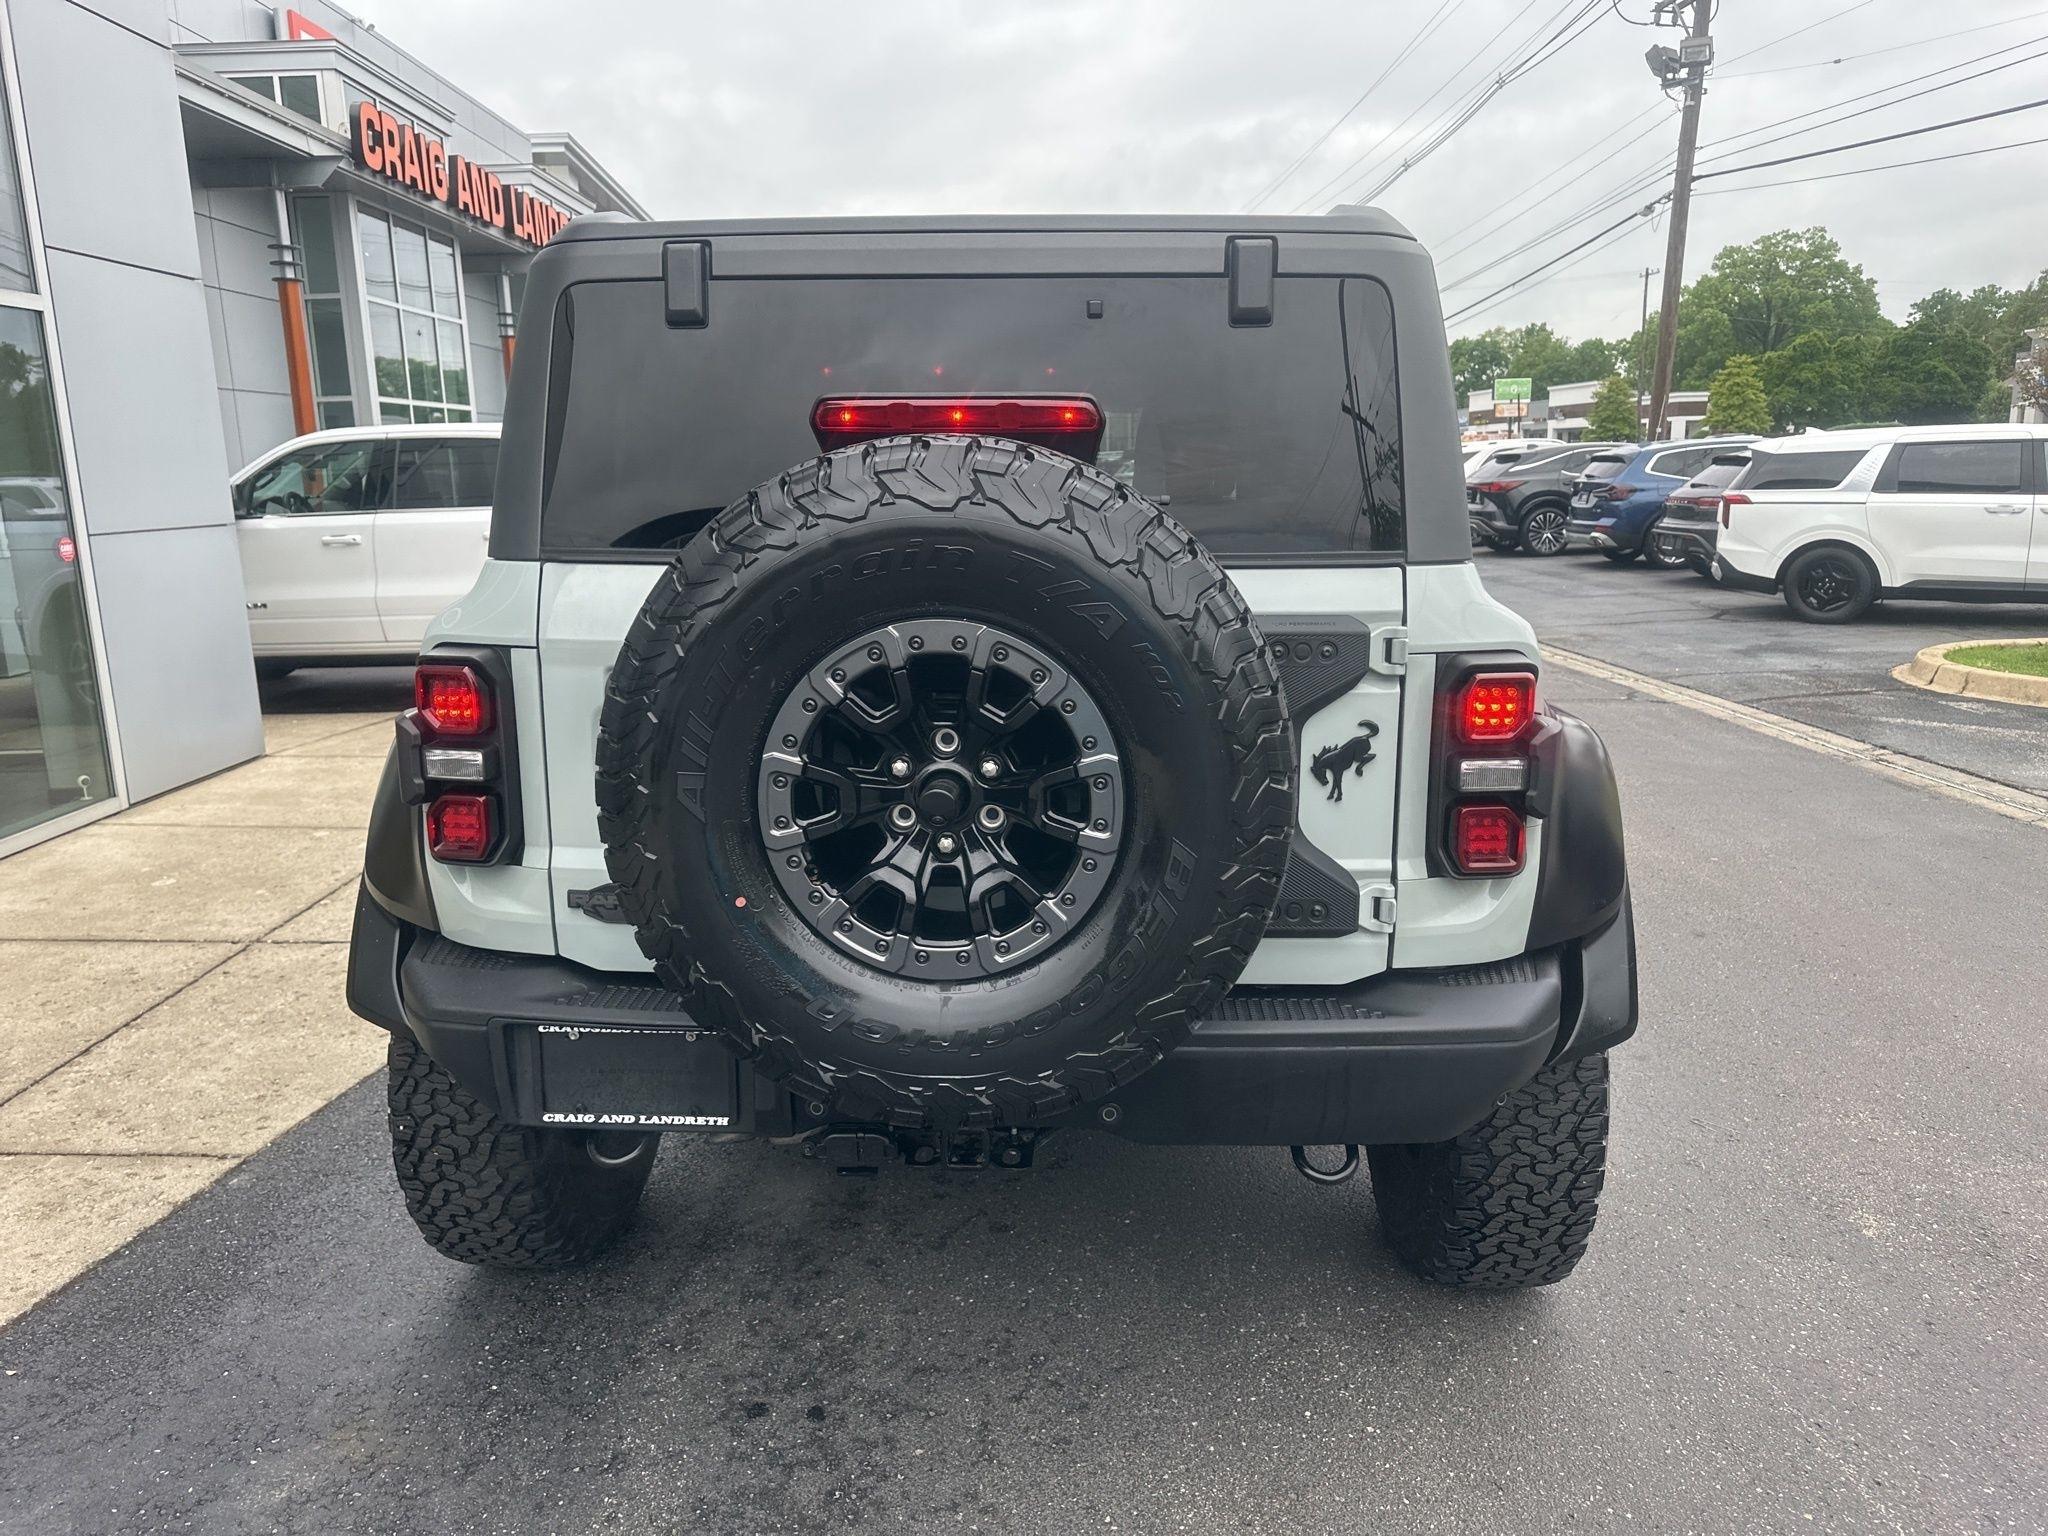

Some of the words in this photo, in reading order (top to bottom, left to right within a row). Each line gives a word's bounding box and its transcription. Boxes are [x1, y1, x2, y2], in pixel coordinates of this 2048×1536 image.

[357, 101, 449, 202] CRAIG
[456, 154, 506, 229] AND
[542, 1113, 596, 1123] CRAIG
[598, 1114, 636, 1124] AND
[638, 1115, 729, 1126] LANDRETH
